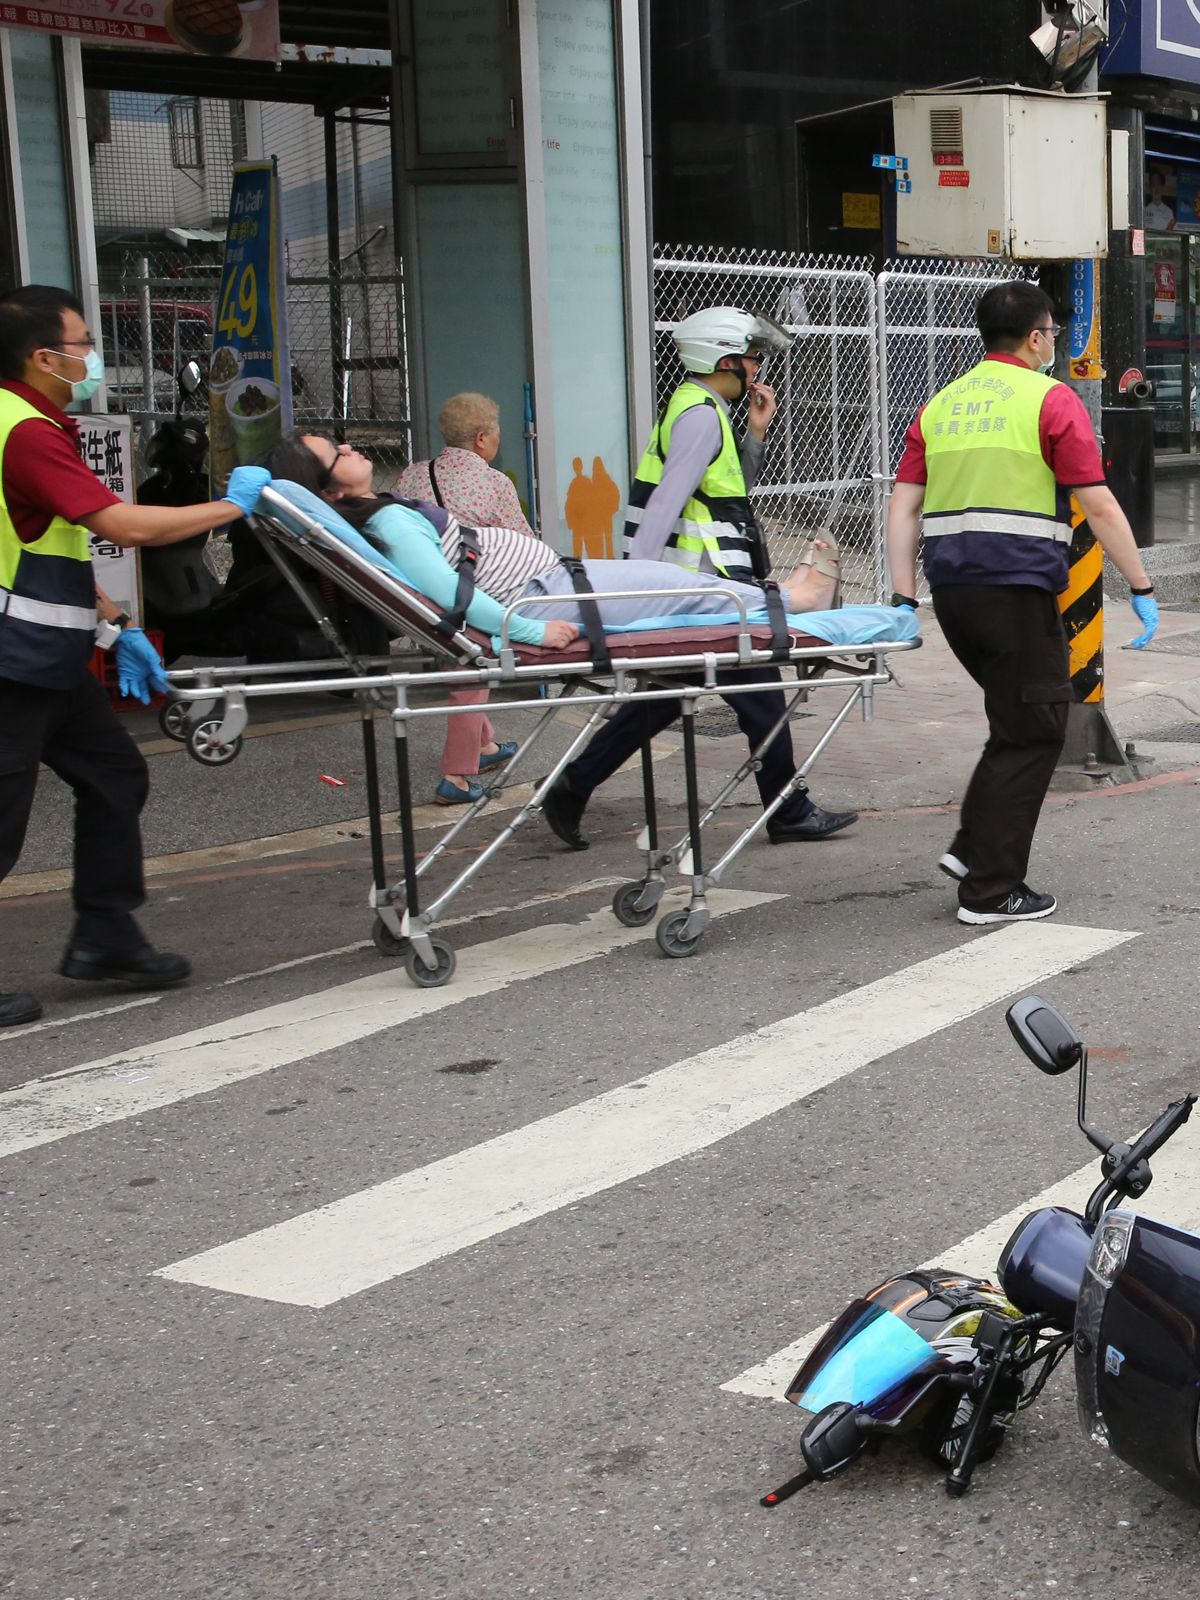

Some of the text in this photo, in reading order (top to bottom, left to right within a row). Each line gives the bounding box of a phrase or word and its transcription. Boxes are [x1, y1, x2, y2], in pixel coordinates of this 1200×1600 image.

[546, 135, 562, 151] life
[218, 263, 259, 342] 49
[951, 399, 995, 416] EMT
